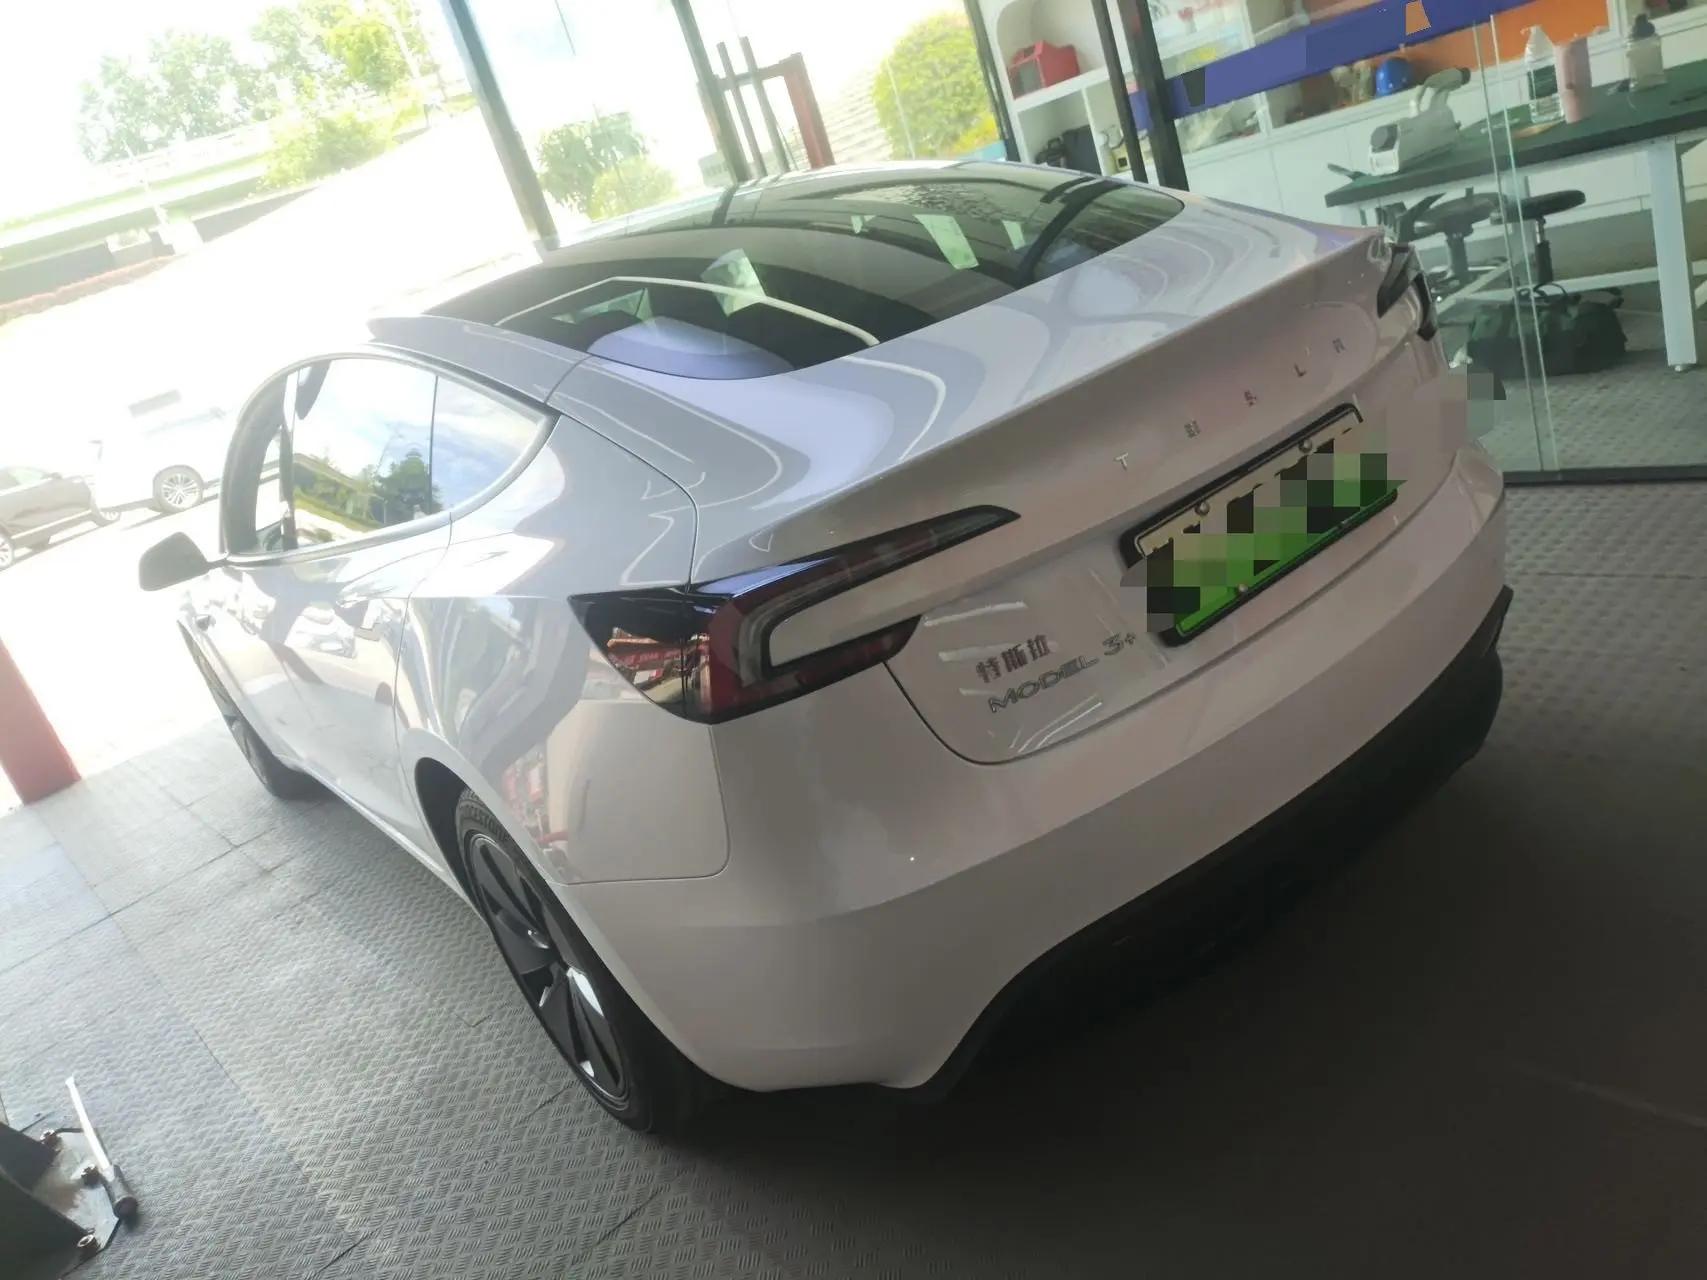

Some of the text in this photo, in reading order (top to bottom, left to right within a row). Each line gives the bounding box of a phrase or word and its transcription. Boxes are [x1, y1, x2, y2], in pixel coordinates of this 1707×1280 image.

[976, 635, 1051, 683] 特斯拉
[988, 655, 1100, 713] MODEL
